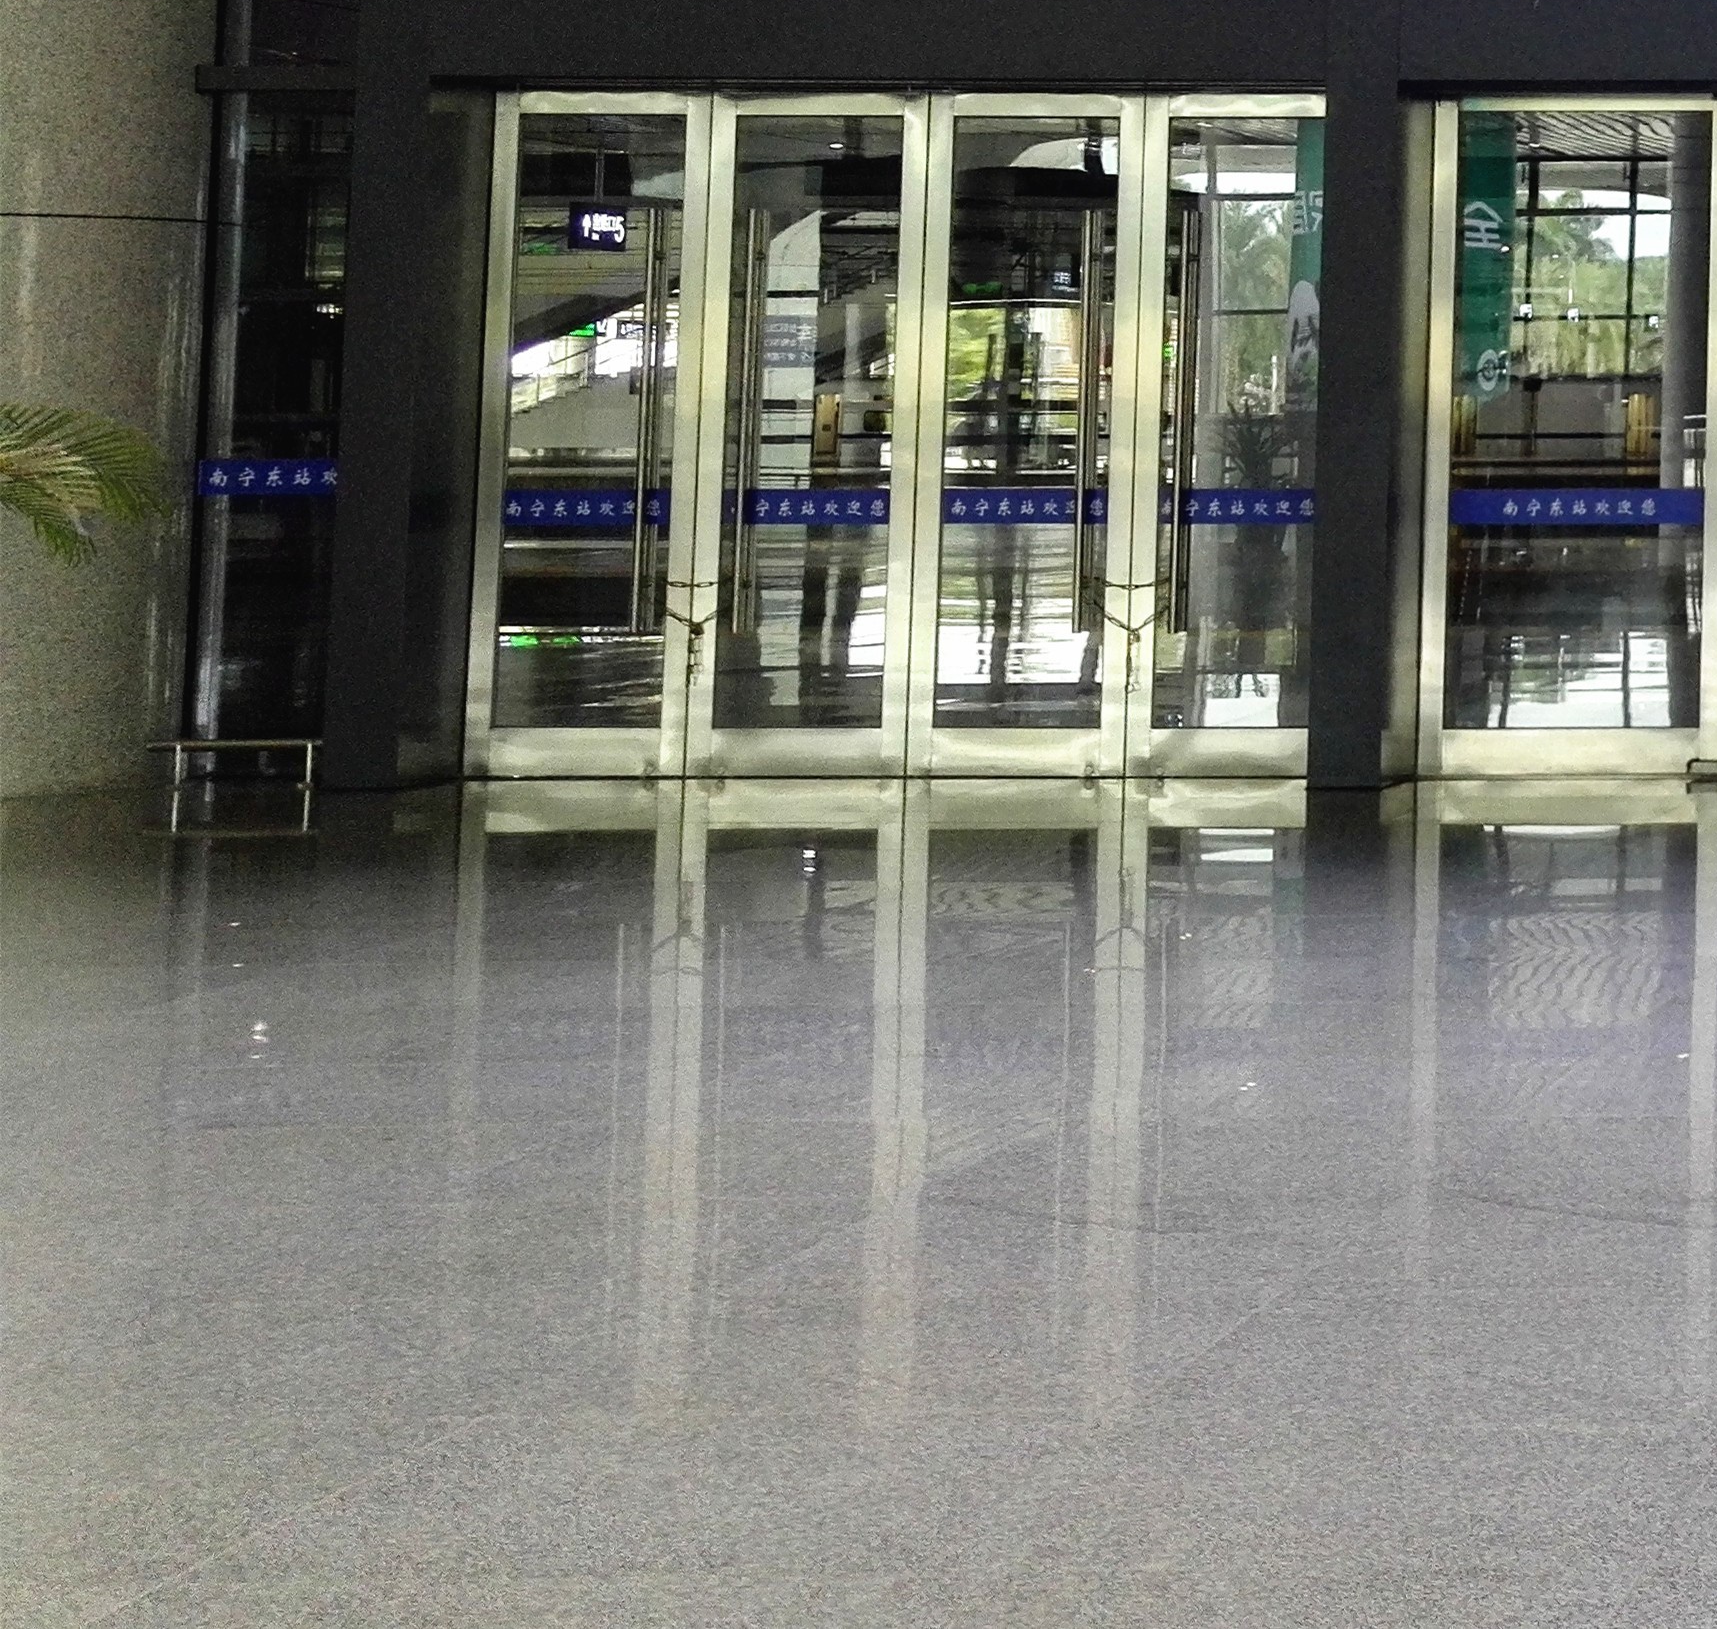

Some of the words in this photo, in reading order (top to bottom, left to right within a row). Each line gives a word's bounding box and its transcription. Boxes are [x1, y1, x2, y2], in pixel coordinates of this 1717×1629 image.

[1502, 497, 1657, 517] 南宁东站欢迎您
